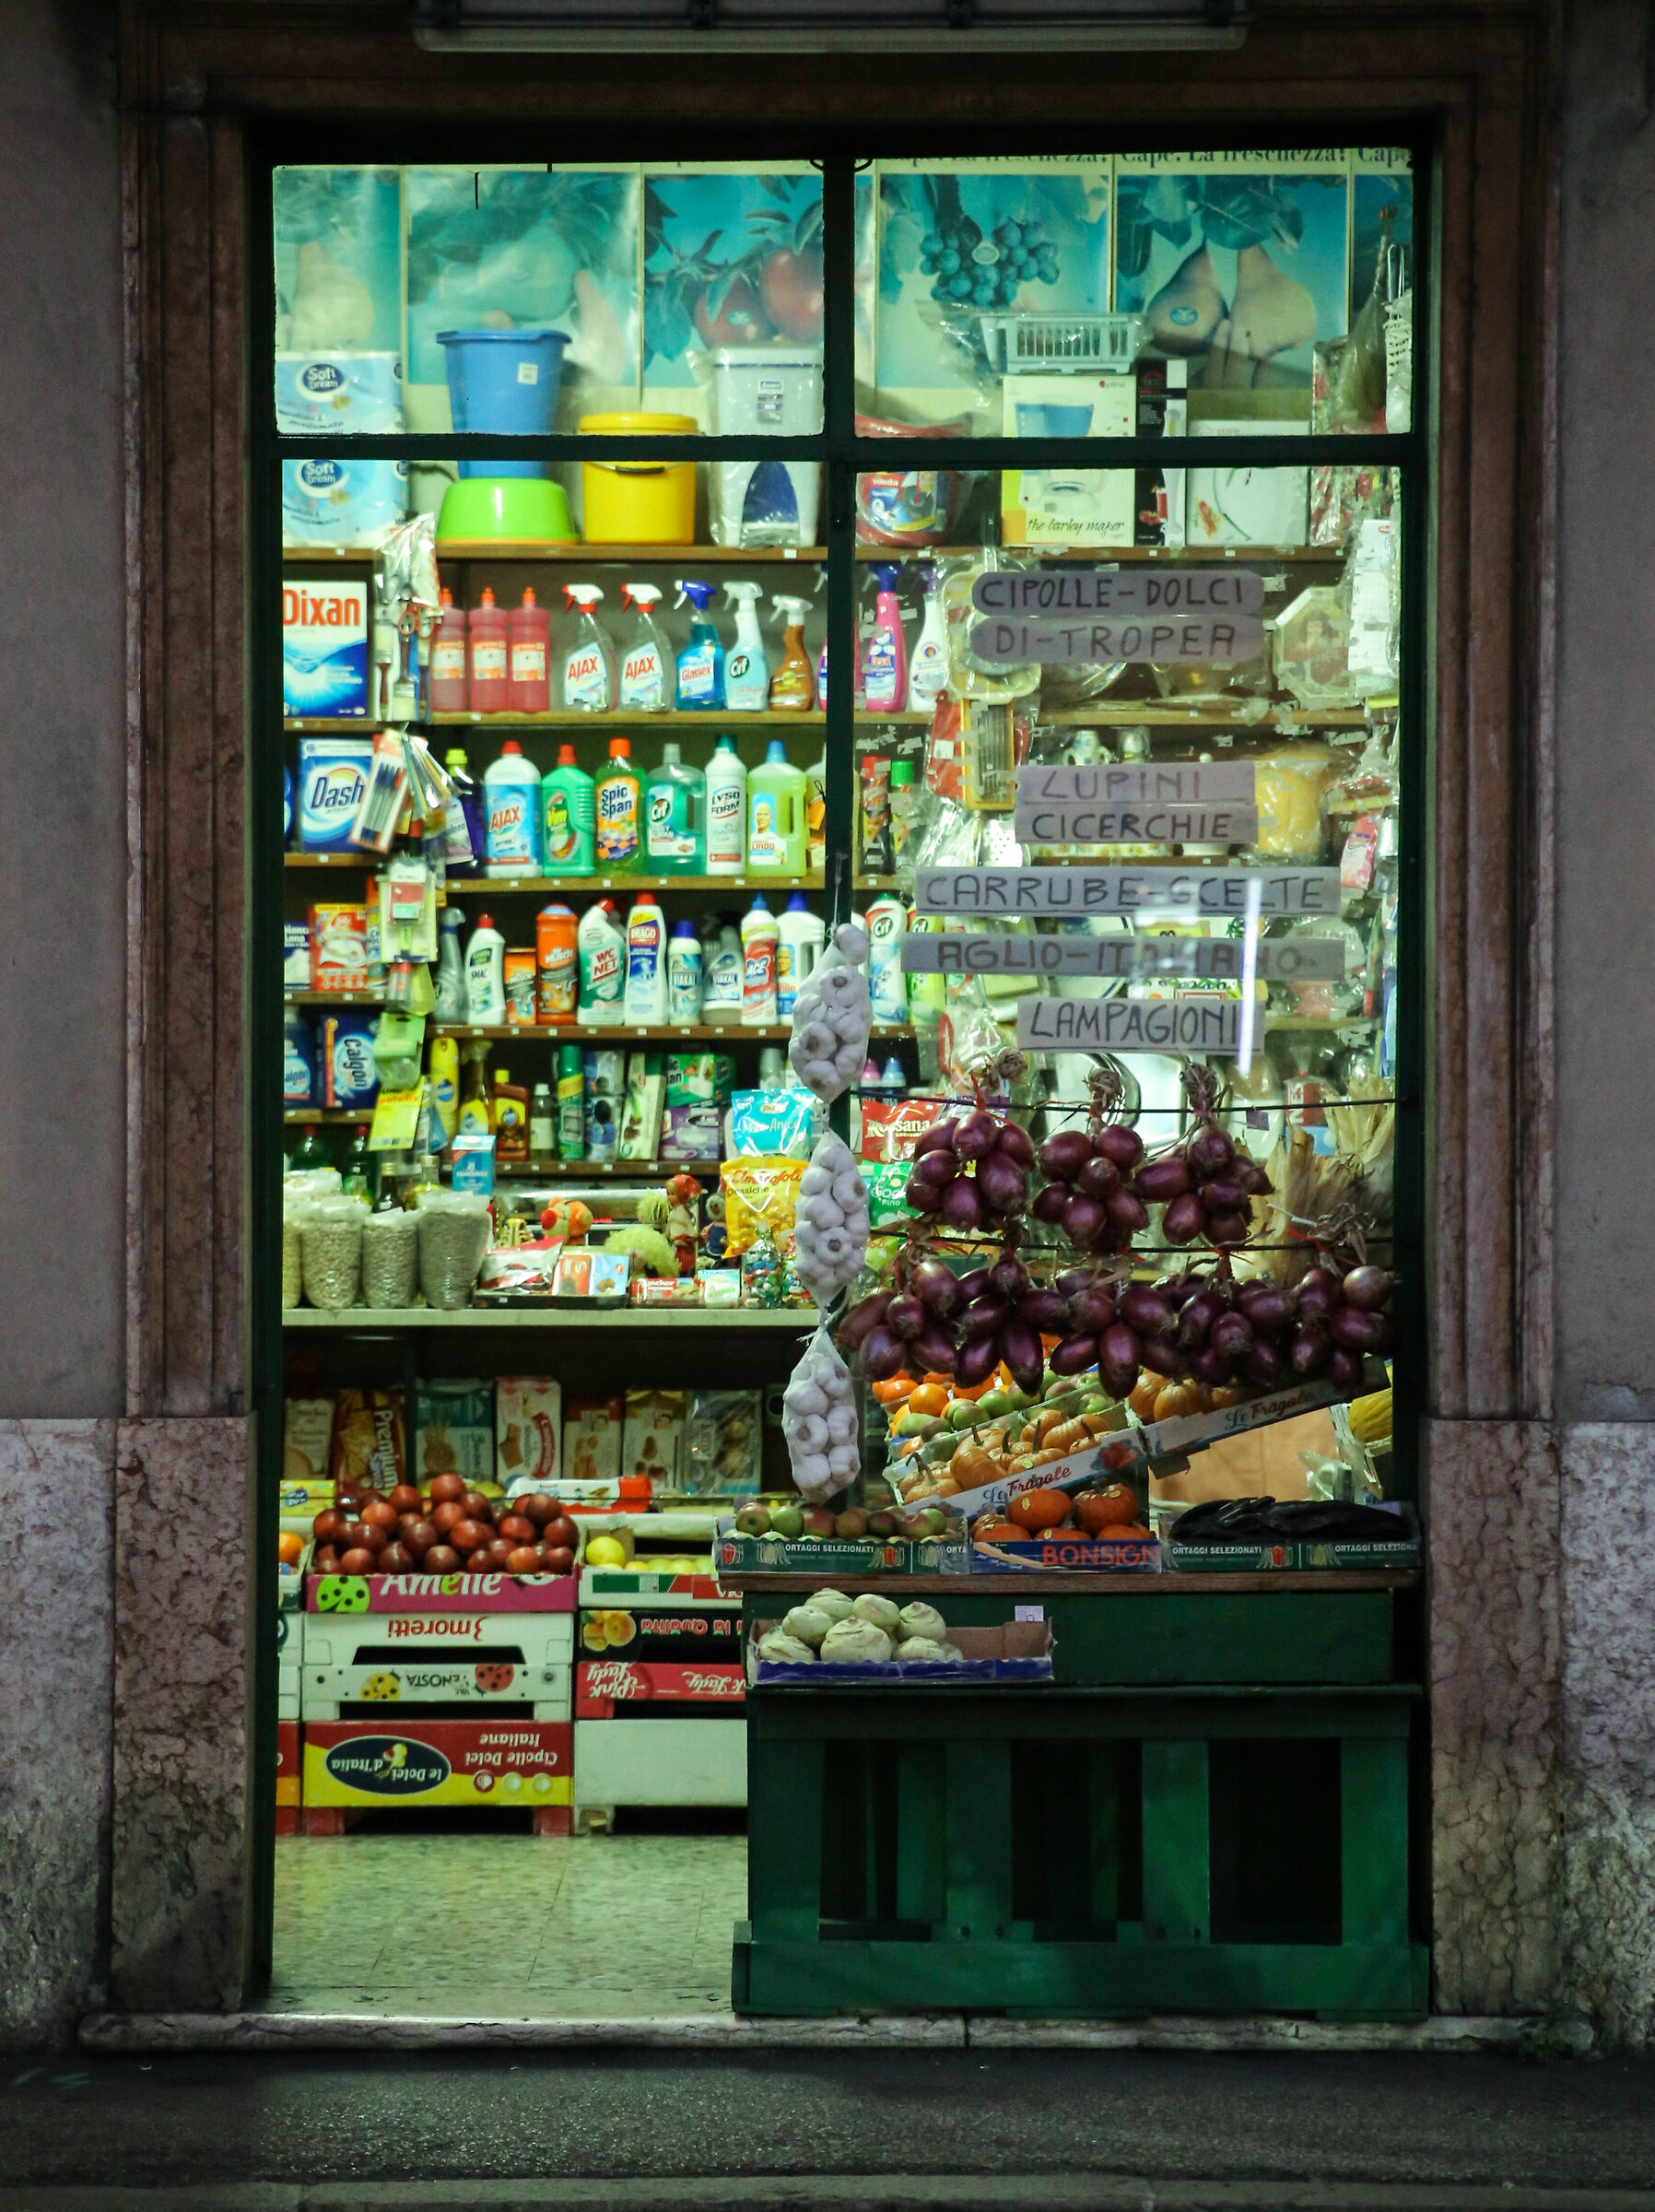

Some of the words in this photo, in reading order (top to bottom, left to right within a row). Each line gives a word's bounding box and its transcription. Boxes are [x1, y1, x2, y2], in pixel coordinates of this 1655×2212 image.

[308, 368, 337, 381] Soft
[310, 380, 340, 389] Dream
[306, 464, 335, 476] Soft
[308, 474, 336, 485] Dream
[872, 478, 899, 487] vileda
[1026, 518, 1046, 532] the
[1047, 518, 1083, 535] barley
[1086, 521, 1125, 538] maker
[283, 589, 360, 627] Dixan
[568, 655, 598, 680] AJAX
[625, 655, 654, 679] AJAX
[681, 665, 711, 682] Glassex
[311, 776, 364, 809] Dash
[1040, 771, 1200, 799] LUPINI
[602, 785, 628, 805] Spic
[711, 791, 740, 806] LYSO
[602, 800, 632, 818] Span
[711, 801, 740, 815] FORM
[489, 806, 522, 831] AJAX
[1032, 813, 1232, 840] CICERCHIE
[874, 919, 892, 935] Cif
[597, 948, 615, 961] WC
[471, 969, 487, 981] SMAC
[593, 959, 618, 976] NET
[745, 961, 769, 976] ACE
[673, 973, 696, 987] VIAKAL
[712, 973, 737, 985] VIAKAL
[1030, 1002, 1238, 1045] LAMPAGIONI
[344, 1039, 367, 1087] Calgon
[285, 1070, 308, 1085] algon
[733, 1168, 803, 1185] Amosoli
[373, 1409, 399, 1489] Premium
[1042, 1545, 1159, 1567] BONSIGN
[1172, 1547, 1208, 1555] ORTAGGI
[1210, 1546, 1262, 1554] SELEZIONATI
[480, 1734, 540, 1747] Italiane
[331, 1759, 383, 1771] d'Italia
[465, 1752, 501, 1766] Dolci
[508, 1750, 558, 1766] Cipolle
[392, 1766, 427, 1781] Dolci
[430, 1770, 443, 1781] le
